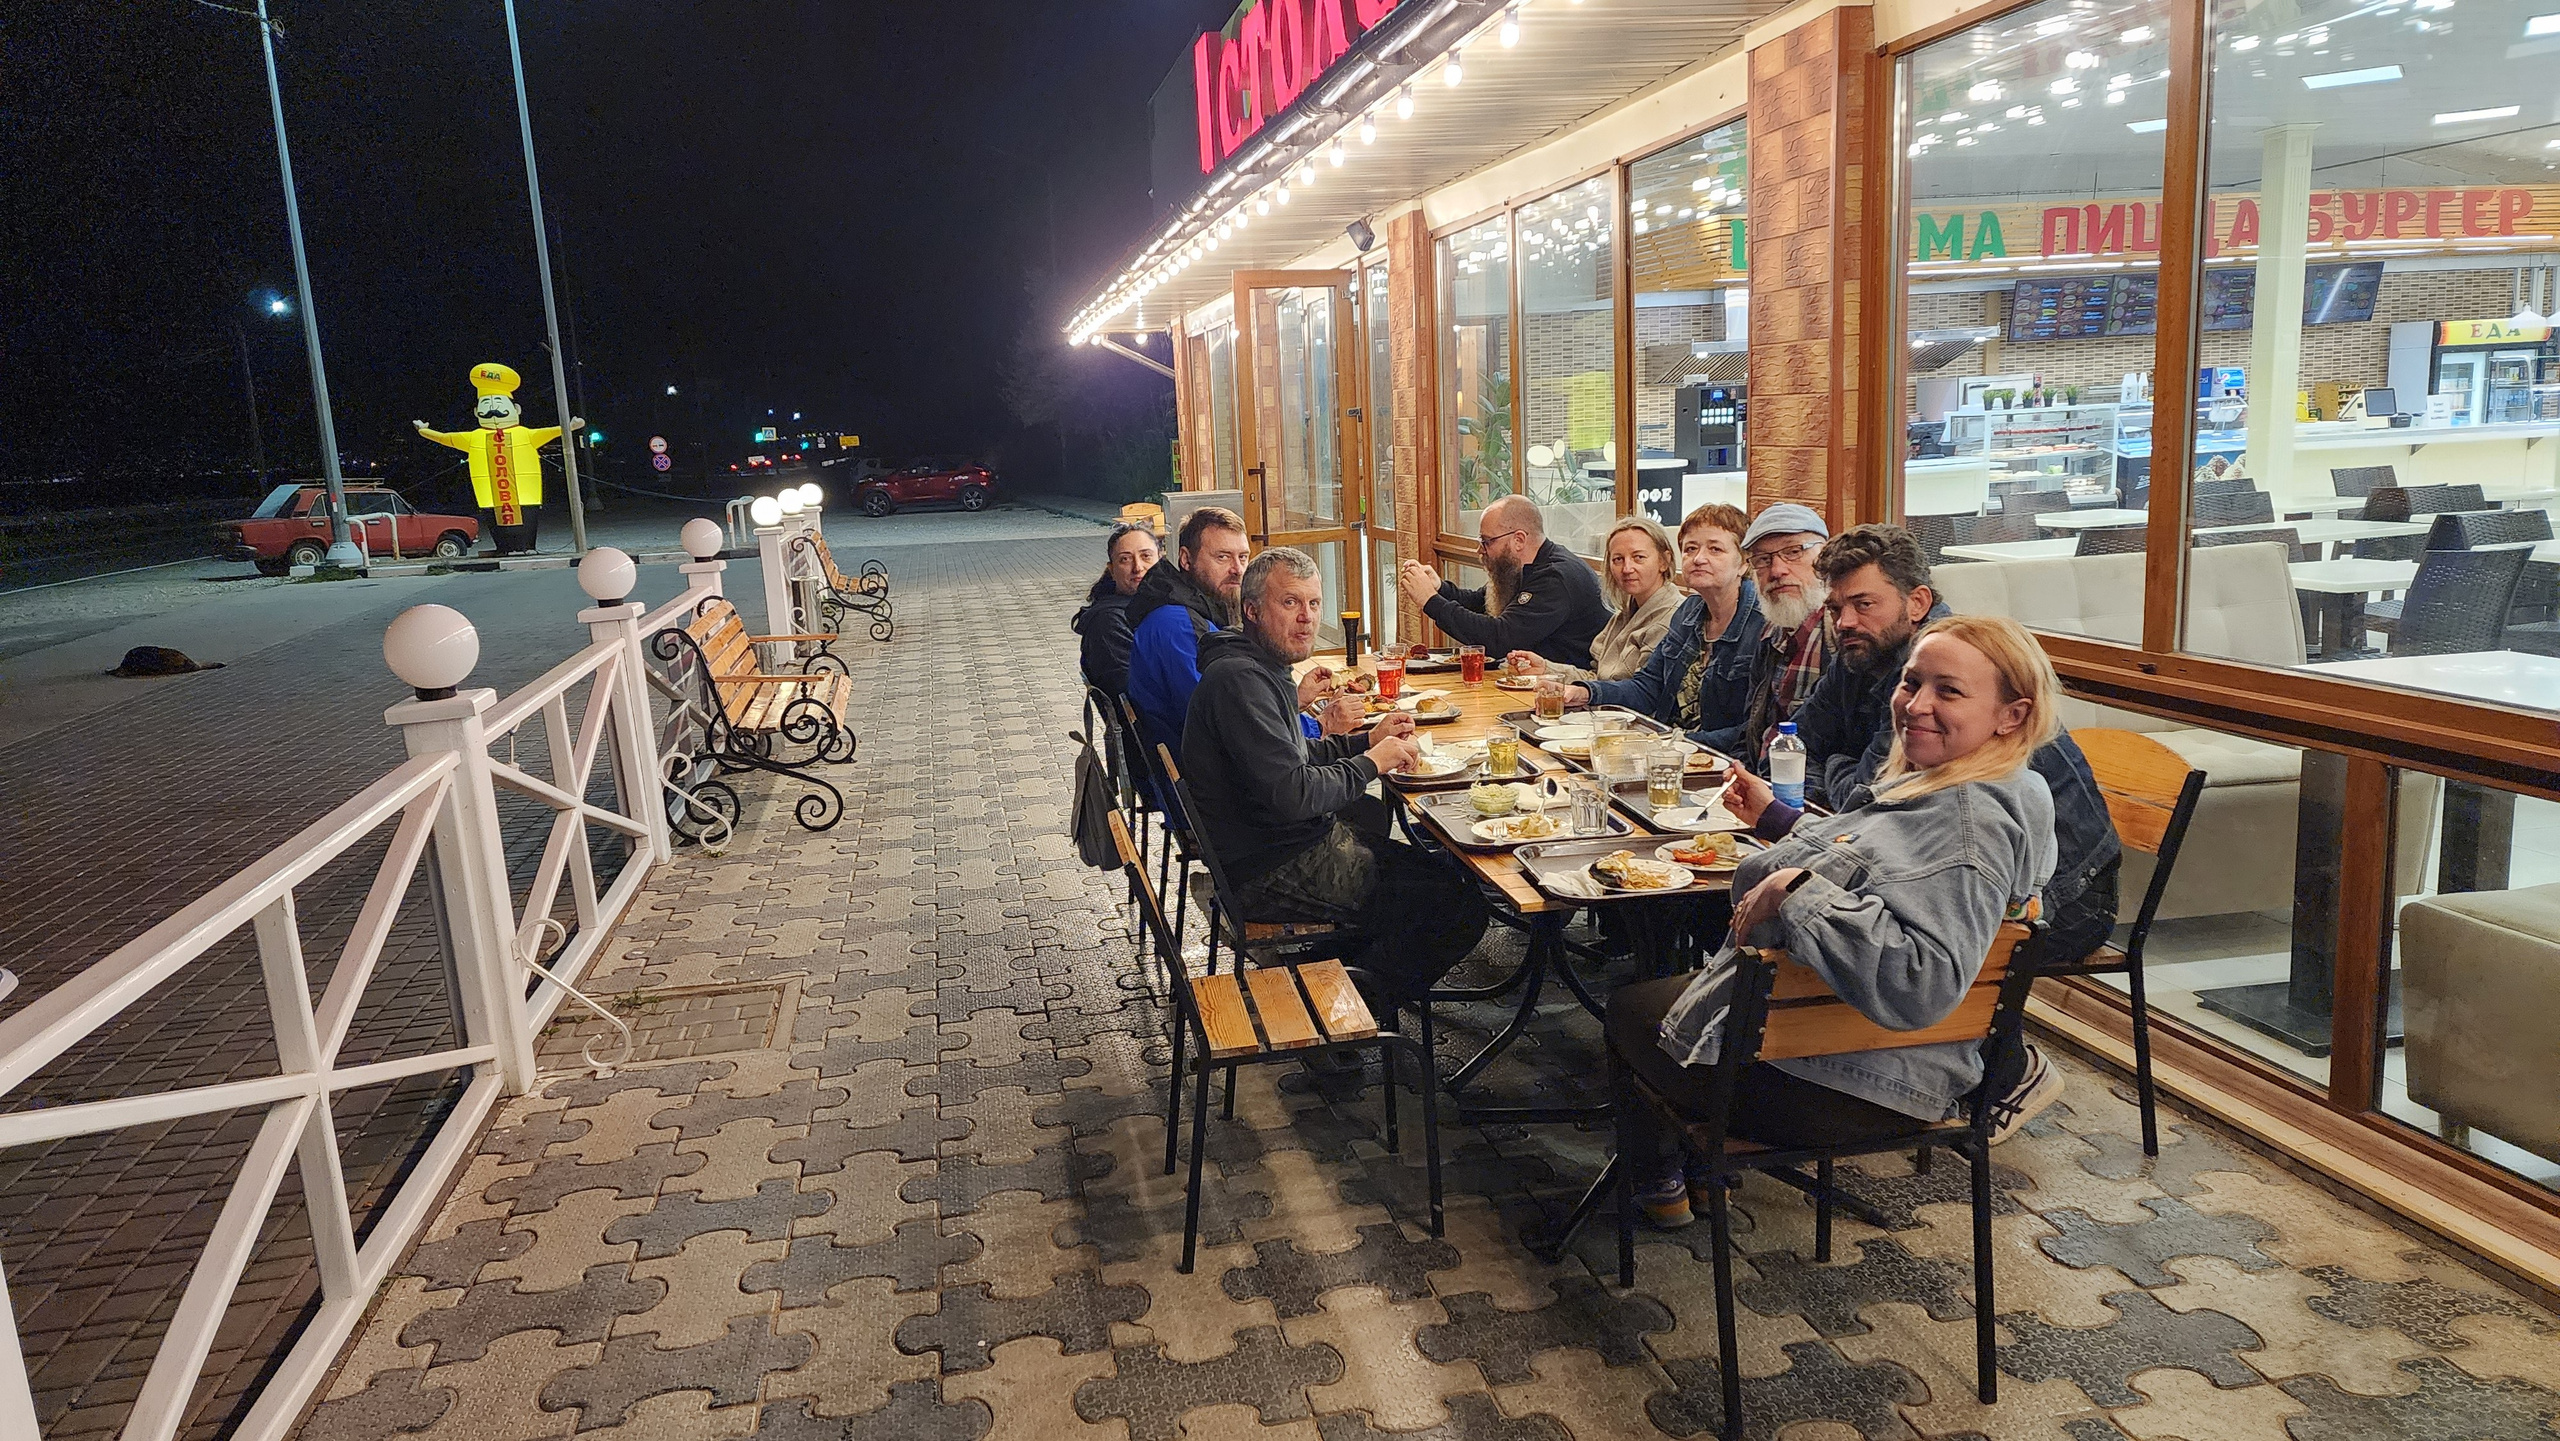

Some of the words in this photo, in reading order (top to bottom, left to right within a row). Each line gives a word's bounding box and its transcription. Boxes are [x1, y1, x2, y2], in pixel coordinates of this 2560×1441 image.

[2308, 188, 2534, 243] БУРГЕР
[493, 431, 515, 525] СТОЛОВАЯ
[1636, 487, 1673, 503] ОФЕ
